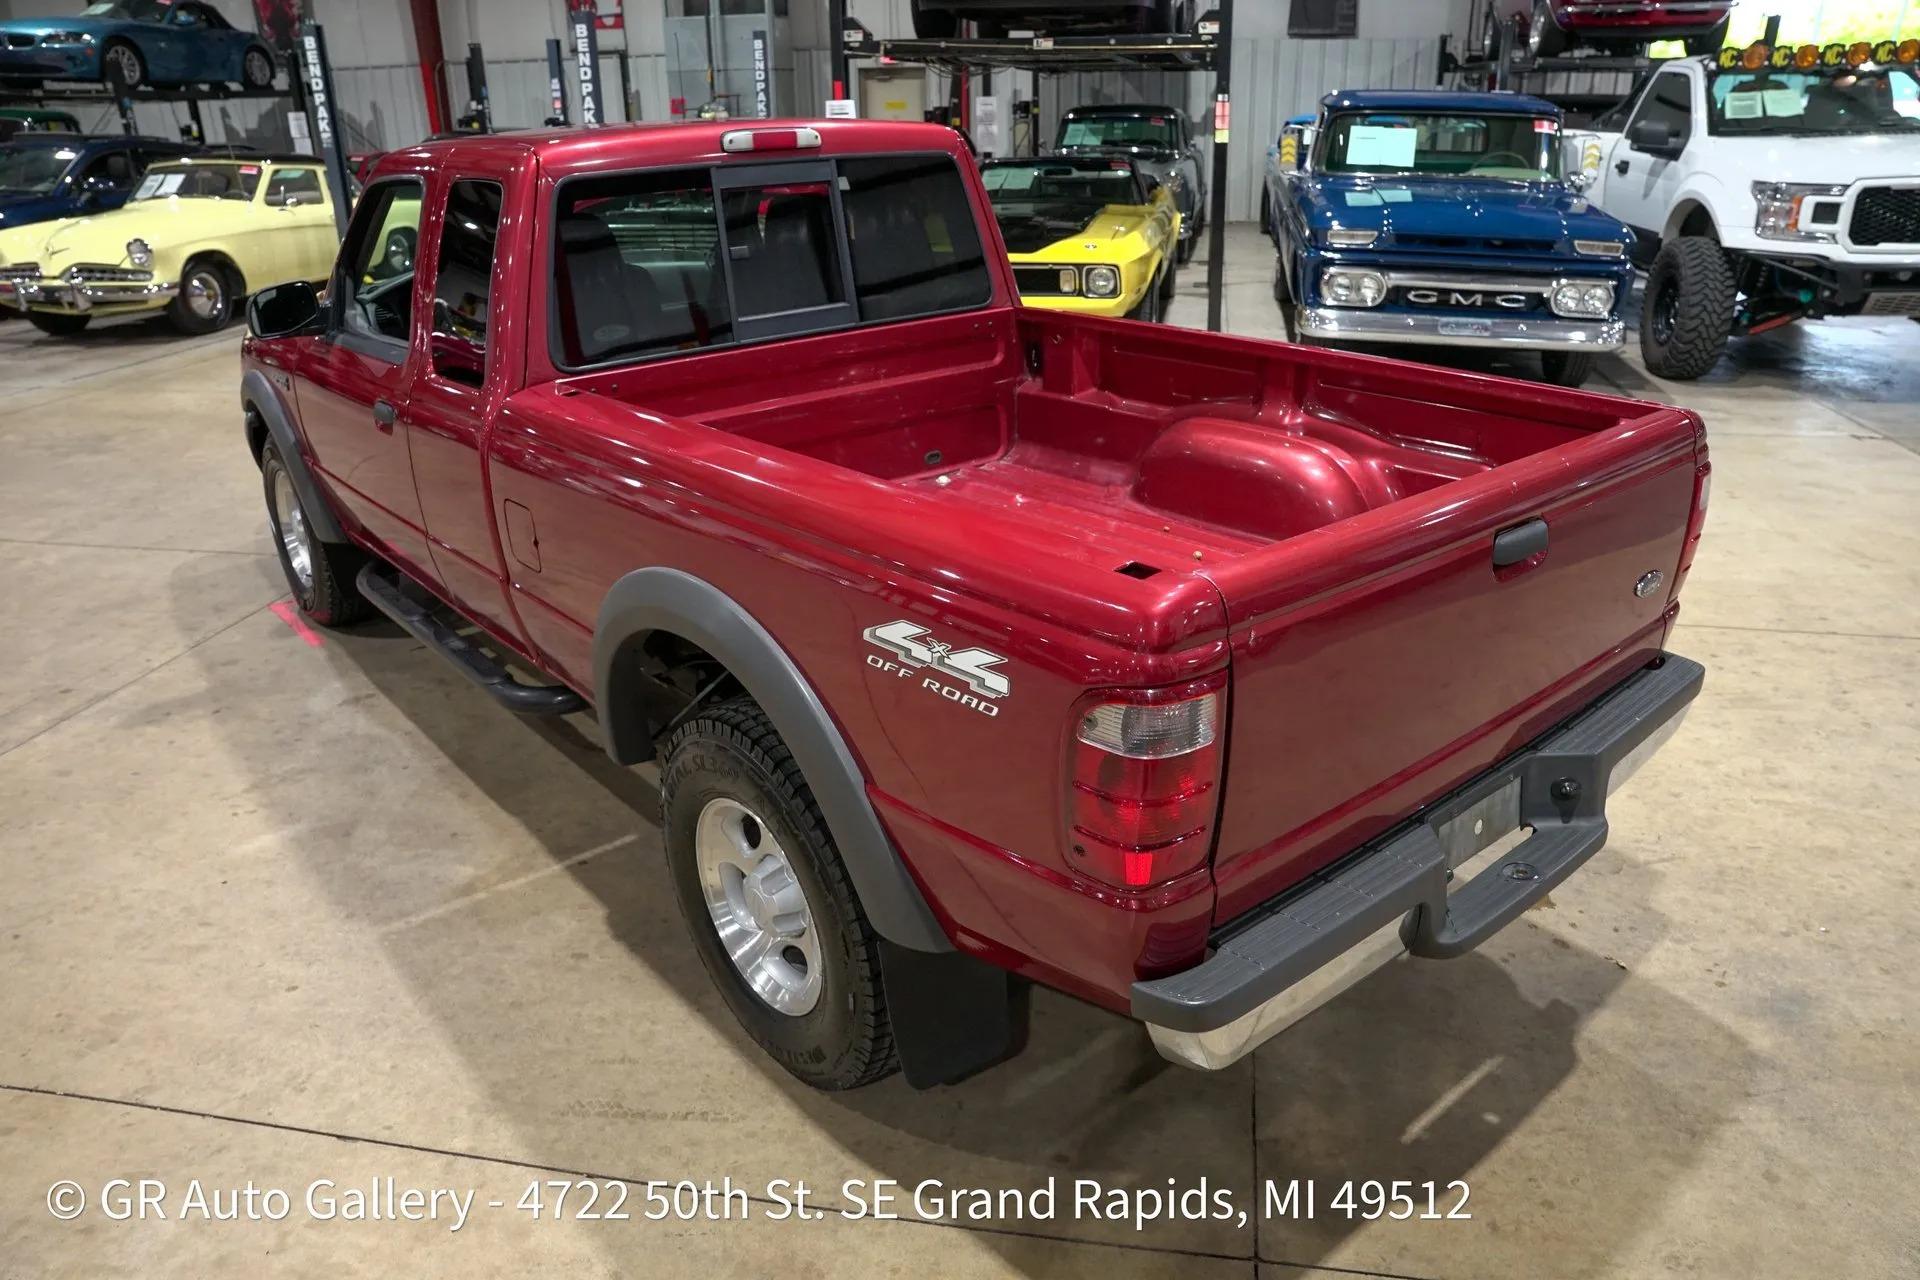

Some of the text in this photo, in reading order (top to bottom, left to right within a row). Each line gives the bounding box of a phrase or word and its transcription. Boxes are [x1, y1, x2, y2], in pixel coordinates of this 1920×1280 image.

[303, 36, 331, 132] BENDPAK
[574, 23, 598, 124] BENDPAK
[753, 39, 767, 112] BENDPAK
[1406, 290, 1527, 308] GMC
[866, 654, 999, 718] OFF ROAD
